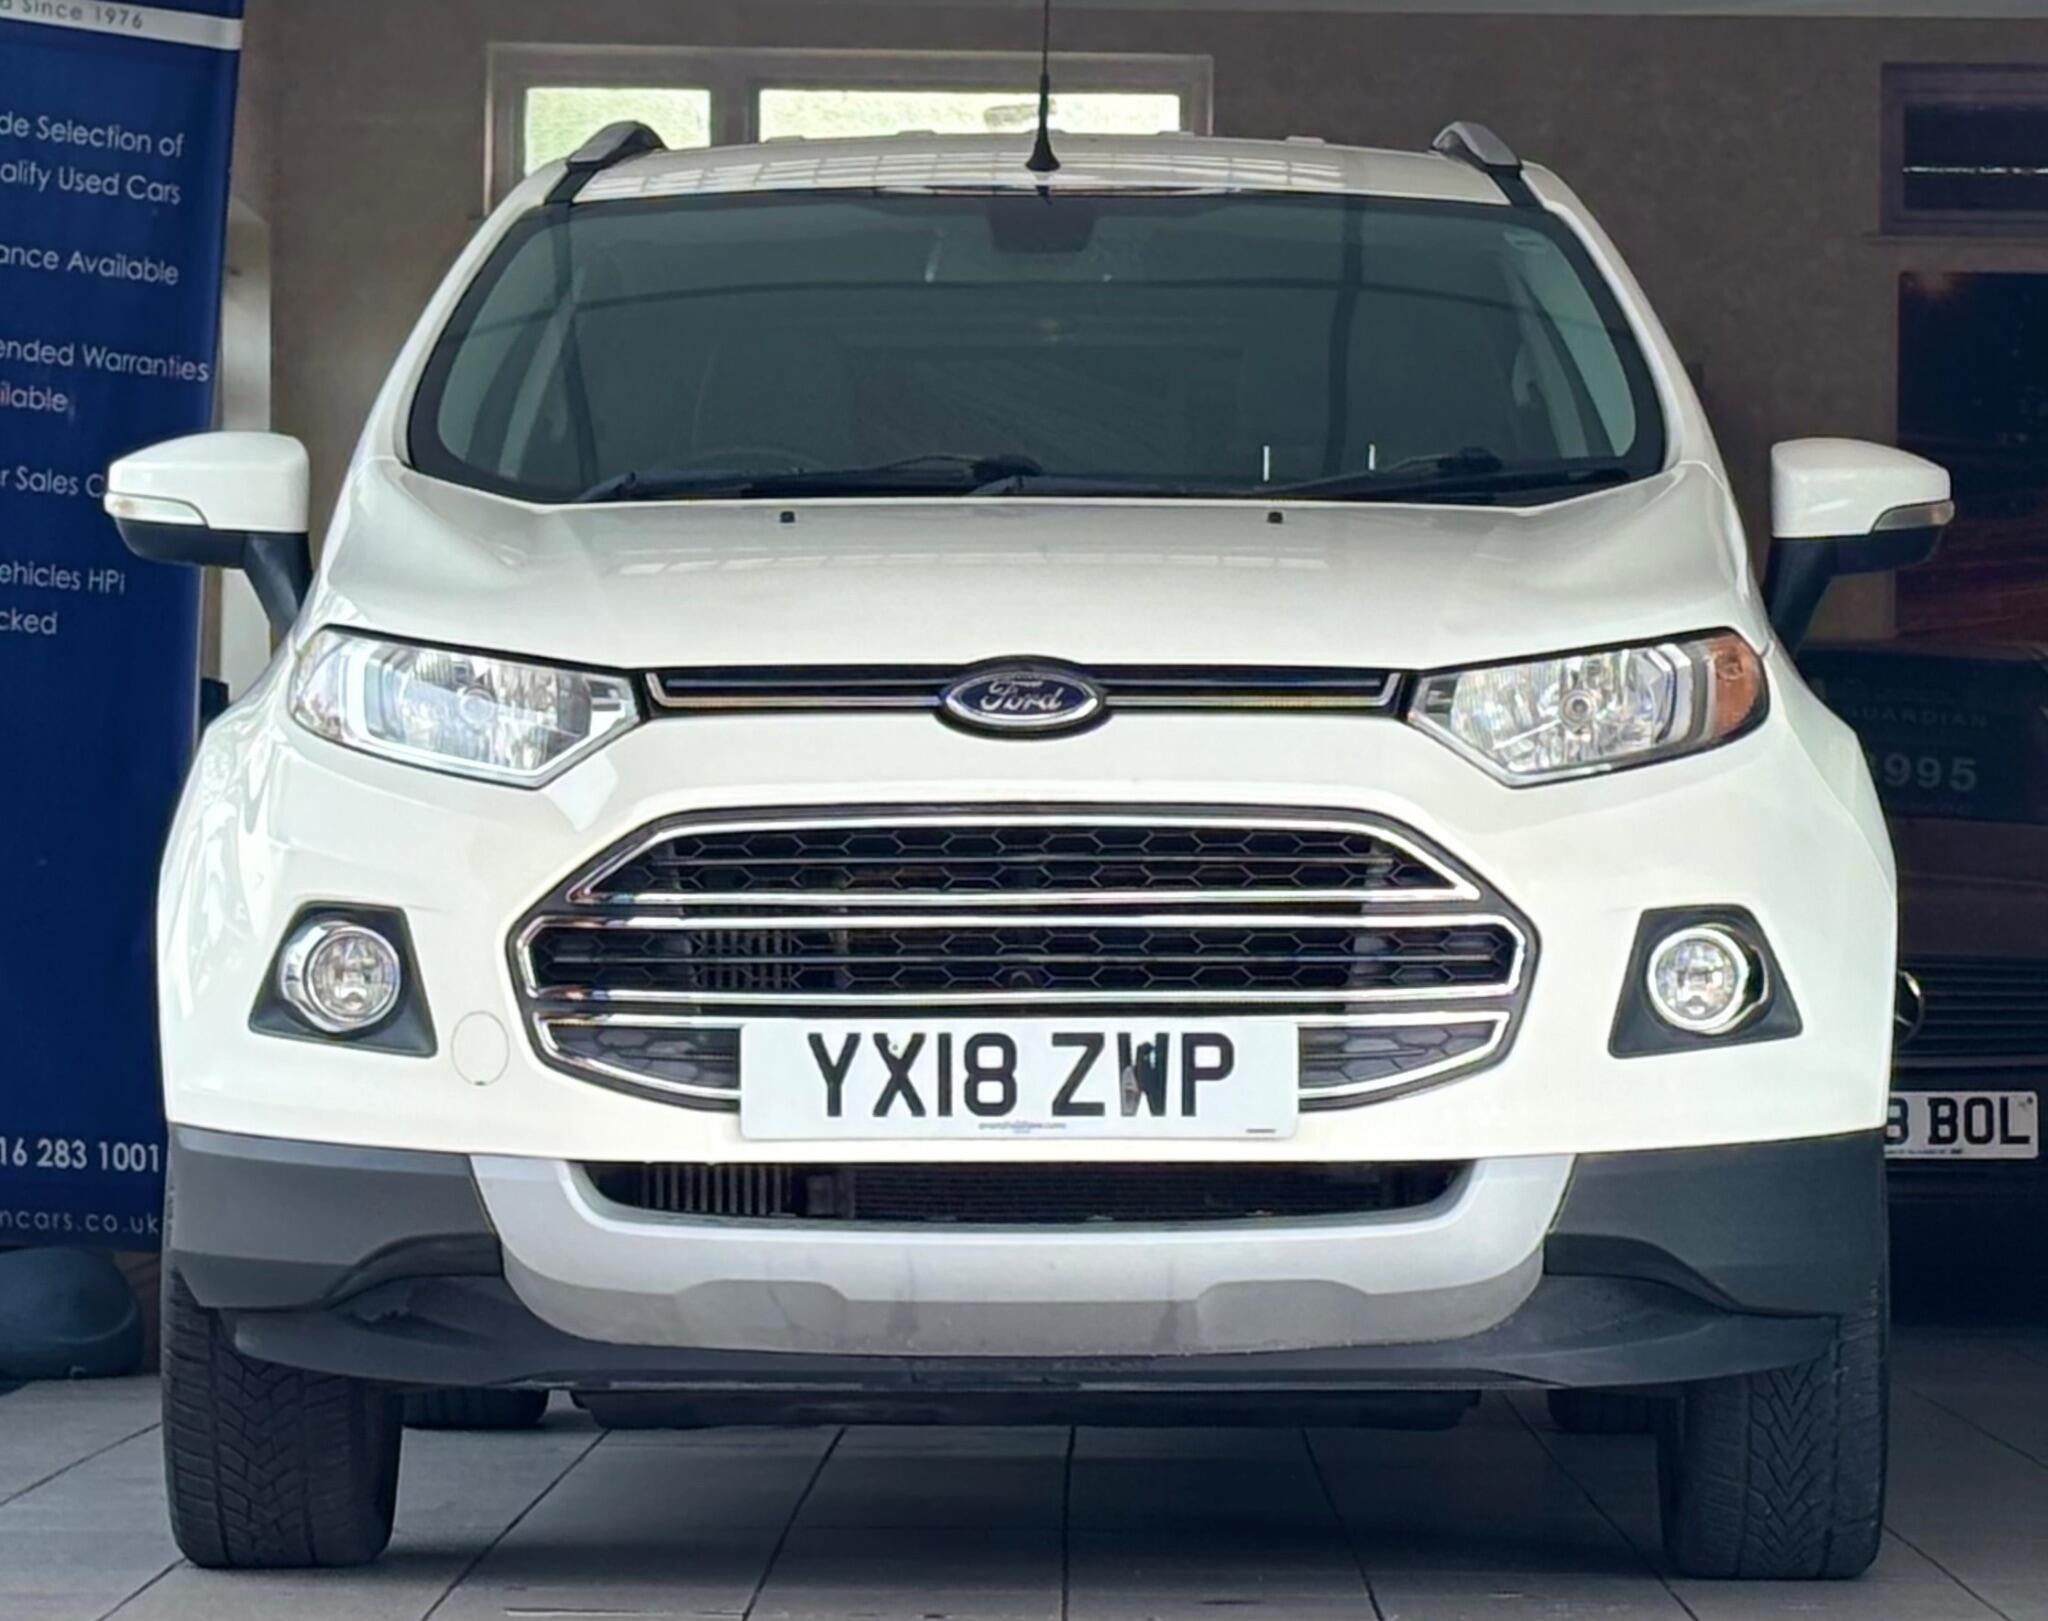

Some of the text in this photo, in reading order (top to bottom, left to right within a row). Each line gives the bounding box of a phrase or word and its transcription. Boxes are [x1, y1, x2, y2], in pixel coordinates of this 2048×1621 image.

[22, 0, 83, 21] Since
[96, 6, 144, 30] 1976
[36, 115, 151, 154] Selection
[158, 132, 185, 157] of
[0, 159, 181, 205] ality Used Cars
[66, 250, 179, 285] Available
[82, 344, 210, 382] Warranties
[16, 465, 79, 496] Sales
[0, 560, 82, 591] ehicles
[979, 680, 1064, 711] Ford
[807, 1032, 1236, 1117] YX18 ZWP
[1927, 1096, 2032, 1145] BOL
[36, 1138, 88, 1169] 283
[98, 1141, 160, 1173] 1001
[0, 1209, 160, 1235] ncars.co.uk
